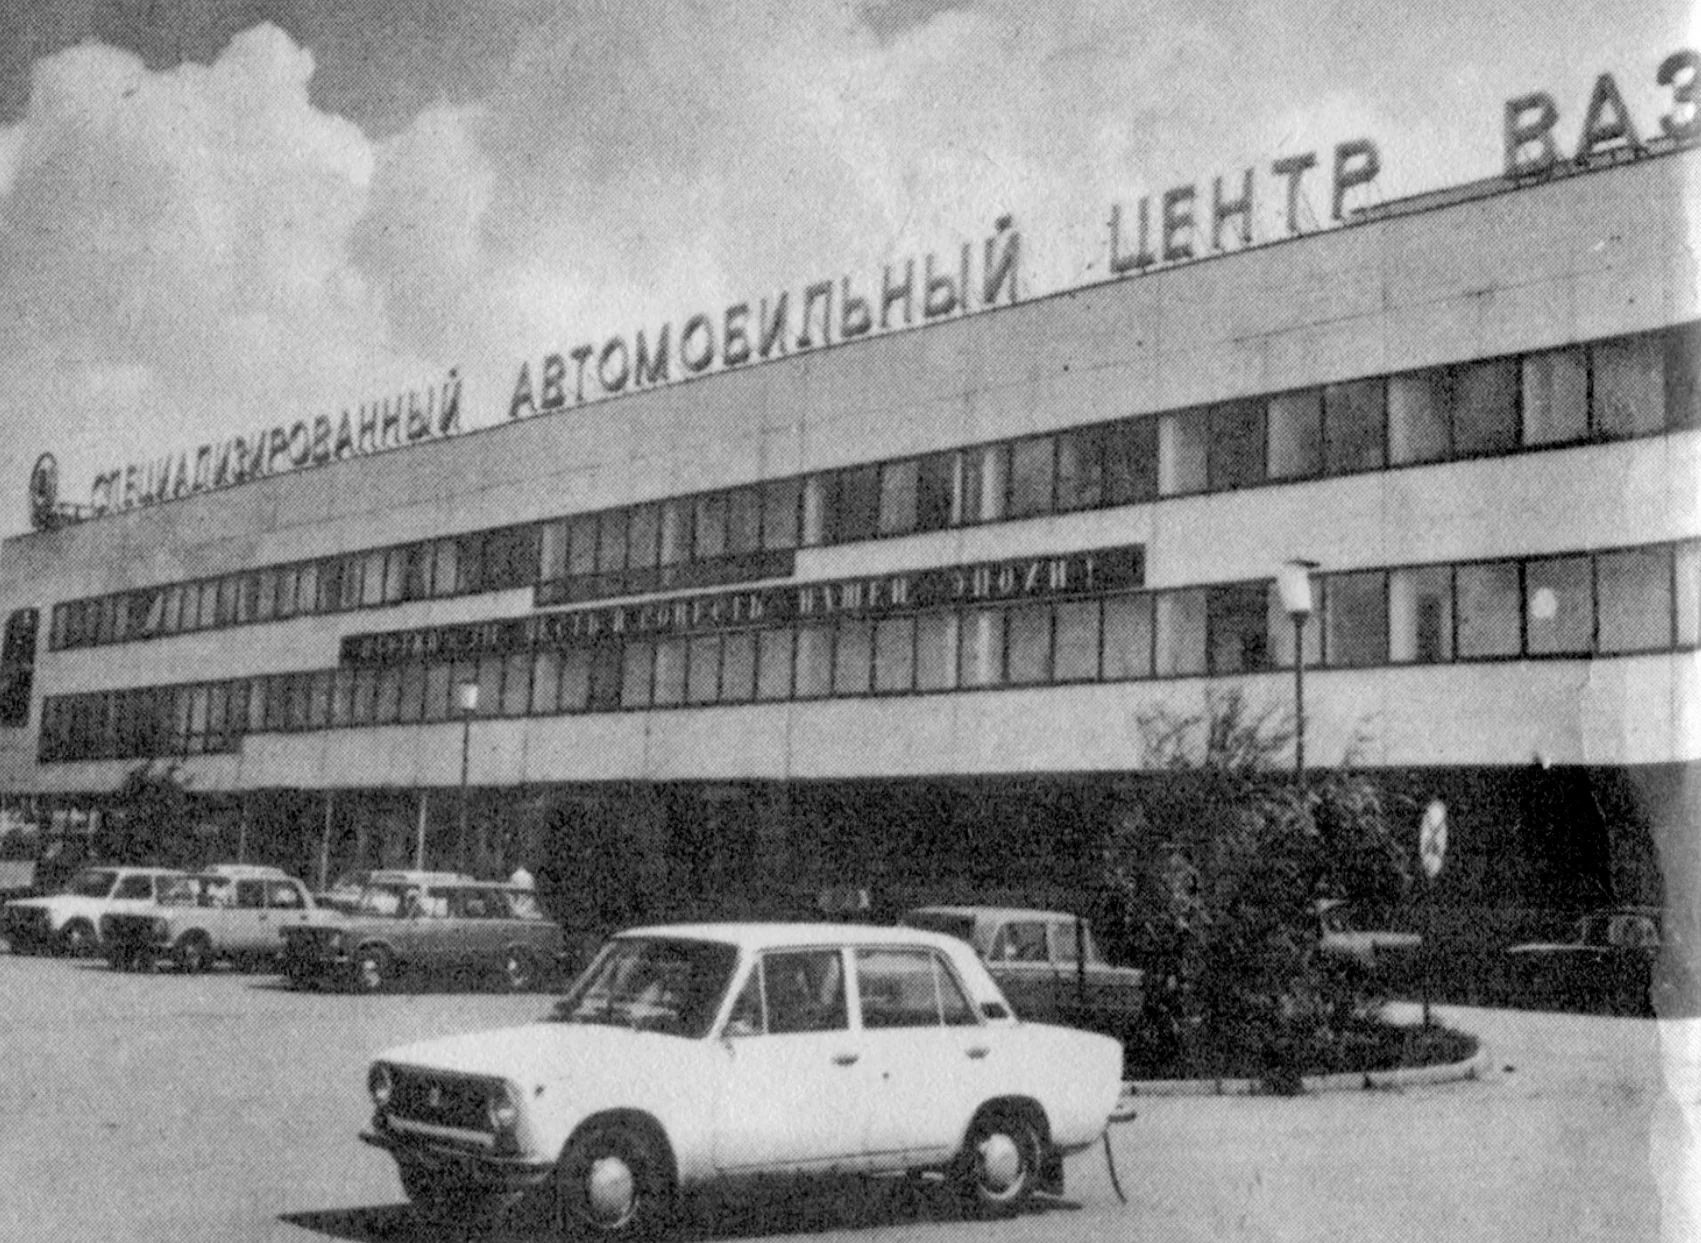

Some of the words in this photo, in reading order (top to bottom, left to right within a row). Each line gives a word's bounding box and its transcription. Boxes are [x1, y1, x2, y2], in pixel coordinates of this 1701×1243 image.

[92, 366, 463, 510] СПЕЦИАЛИЗИРОВАННЫЙ
[508, 213, 1021, 419] АВТОМОБИЛЬНЫЙ
[1109, 138, 1381, 274] ЦЕНТР
[1503, 49, 1701, 181] ВАЗ
